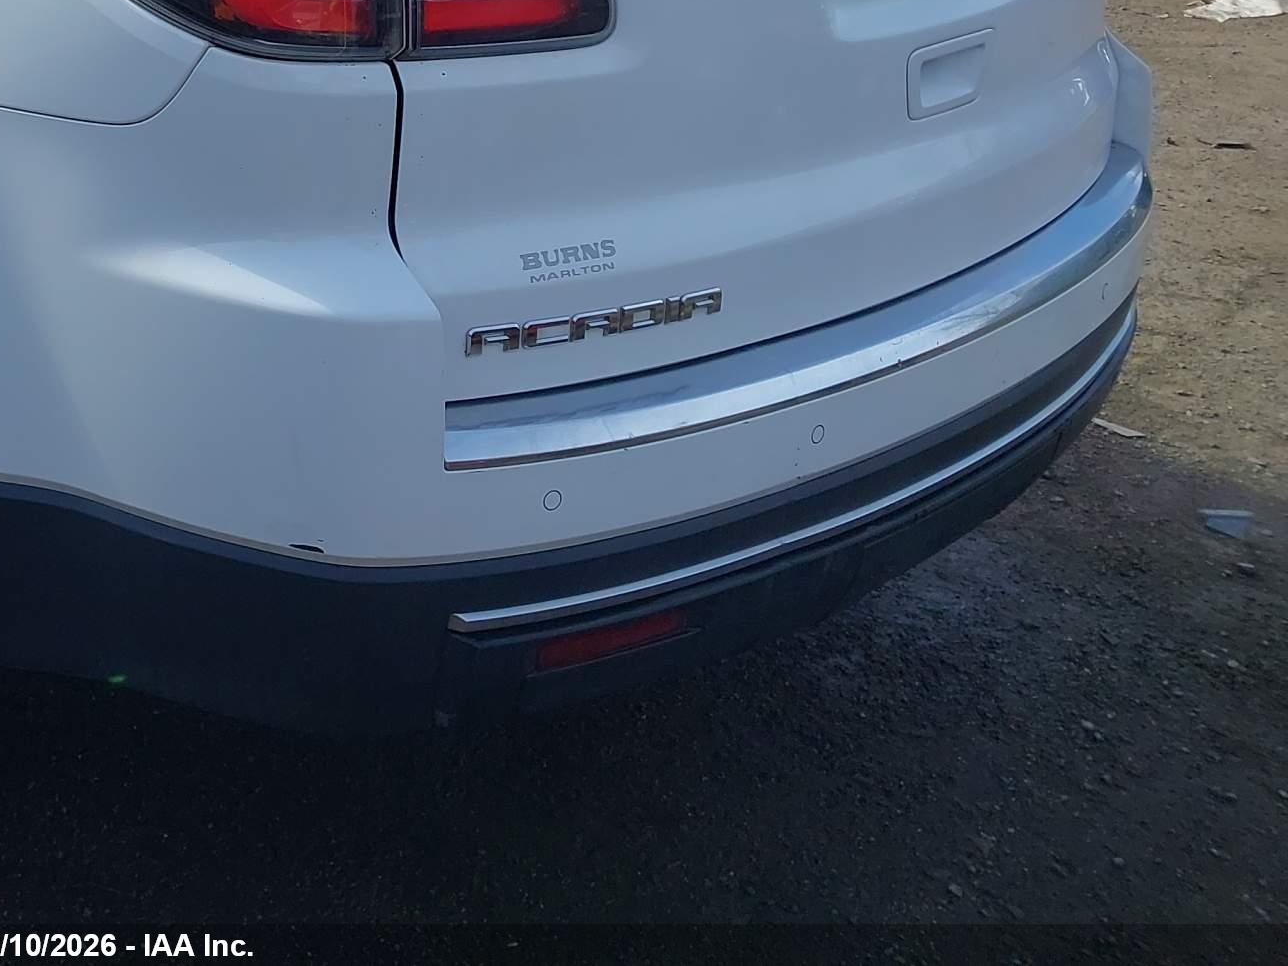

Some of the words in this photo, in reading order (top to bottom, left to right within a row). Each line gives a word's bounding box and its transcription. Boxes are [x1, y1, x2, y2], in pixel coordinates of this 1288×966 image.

[519, 239, 617, 272] BURNS
[529, 261, 616, 284] MARLTON
[464, 286, 724, 358] ACADIA
